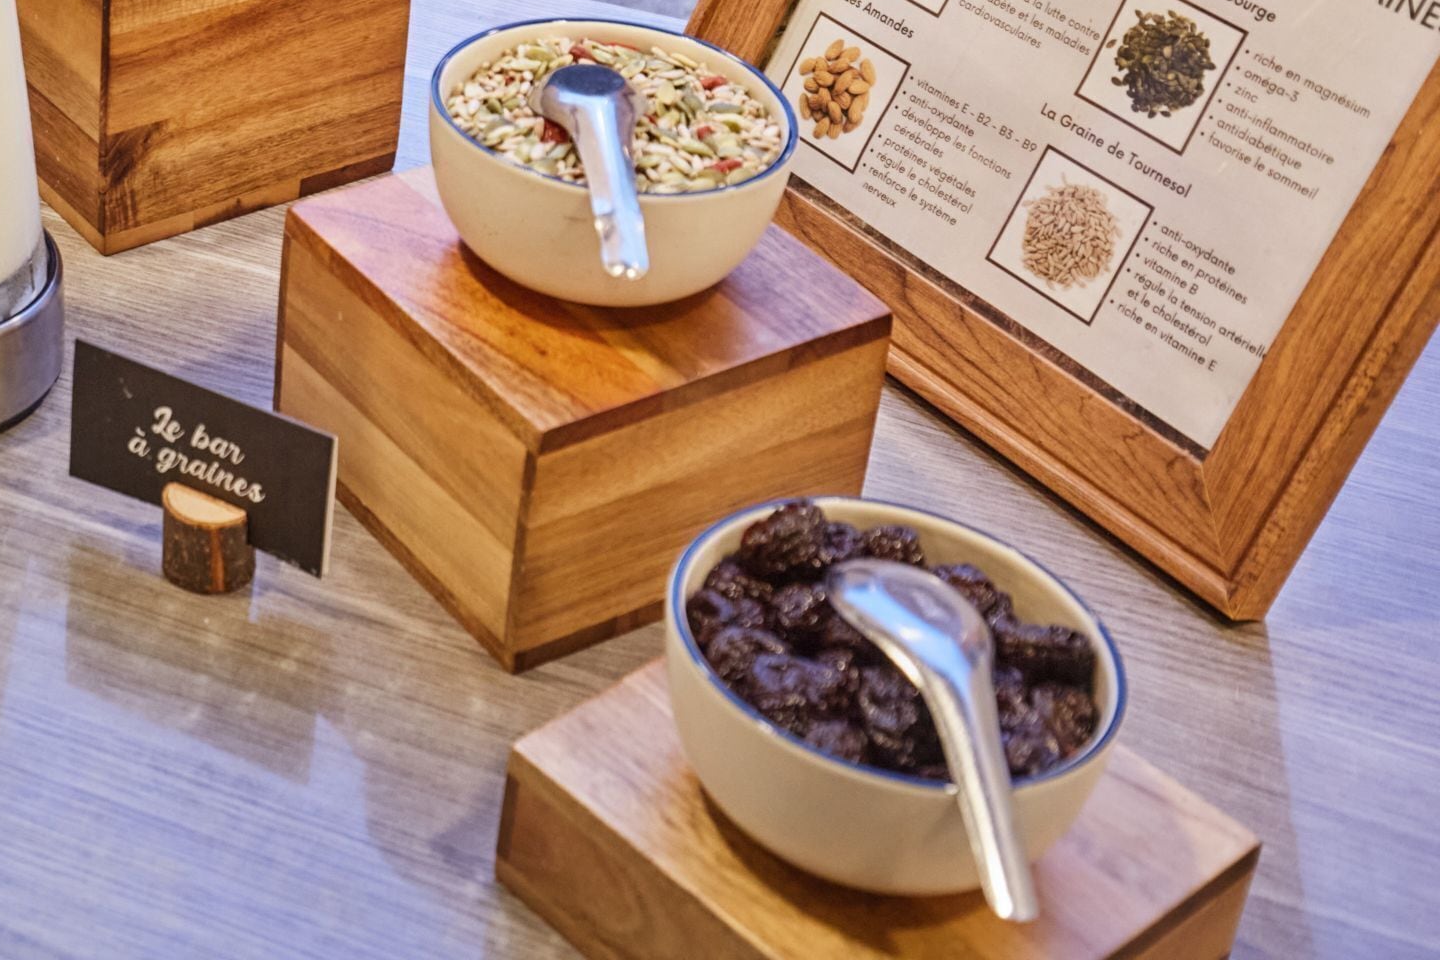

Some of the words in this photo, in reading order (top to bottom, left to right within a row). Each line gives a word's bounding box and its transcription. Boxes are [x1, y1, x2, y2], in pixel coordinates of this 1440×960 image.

[863, 2, 915, 39] Amandes
[959, 0, 1042, 49] cardiovasculaires
[1018, 9, 1029, 21] et
[1030, 15, 1043, 30] les
[1046, 24, 1090, 56] maladies
[1045, 0, 1066, 23] lutte
[1067, 15, 1101, 40] contre
[909, 93, 975, 137] anti-oxydante
[1234, 84, 1258, 104] zinc
[1244, 69, 1299, 102] oméga-3
[1254, 52, 1283, 74] riche
[1287, 69, 1300, 82] en
[1303, 76, 1371, 119] magnésium
[894, 124, 944, 158] cérébrales
[902, 108, 951, 142] développe
[953, 140, 966, 154] les
[968, 145, 1012, 180] fonctions
[917, 79, 960, 110] vitamines
[961, 103, 970, 114] E
[977, 111, 992, 126] B2
[999, 126, 1013, 139] B3
[1021, 139, 1037, 153] B9
[1217, 117, 1303, 171] antidiabétique
[1226, 103, 1335, 166] anti-inflammatoire
[884, 137, 928, 168] protéines
[929, 163, 977, 197] végétales
[1040, 102, 1057, 120] La
[1060, 113, 1105, 148] Graine
[1107, 141, 1125, 160] de
[1128, 153, 1192, 198] Tournesol
[1208, 133, 1252, 165] favorise
[1254, 158, 1265, 173] le
[1268, 170, 1319, 200] sommeil
[862, 182, 896, 208] nerveux
[869, 166, 907, 194] renforce
[909, 188, 918, 200] le
[920, 197, 958, 226] système
[876, 150, 906, 177] régule
[907, 167, 916, 181] le
[918, 174, 972, 215] cholestérol
[1144, 255, 1187, 287] vitamine
[1189, 284, 1200, 295] B
[1152, 239, 1180, 264] riche
[1182, 259, 1195, 271] en
[1196, 265, 1248, 305] protéines
[1161, 225, 1236, 276] anti-oxydante
[1128, 288, 1139, 301] et
[1140, 292, 1150, 308] le
[1152, 302, 1211, 347] cholestérol
[1134, 270, 1166, 297] régule
[1169, 290, 1180, 306] la
[1180, 298, 1217, 329] tension
[1117, 302, 1143, 325] riche
[1145, 320, 1158, 333] en
[1160, 328, 1206, 363] vitamine
[1208, 360, 1218, 372] E
[127, 427, 151, 458] à
[157, 447, 266, 503] graines
[151, 406, 184, 442] Le
[191, 423, 245, 465] bar
